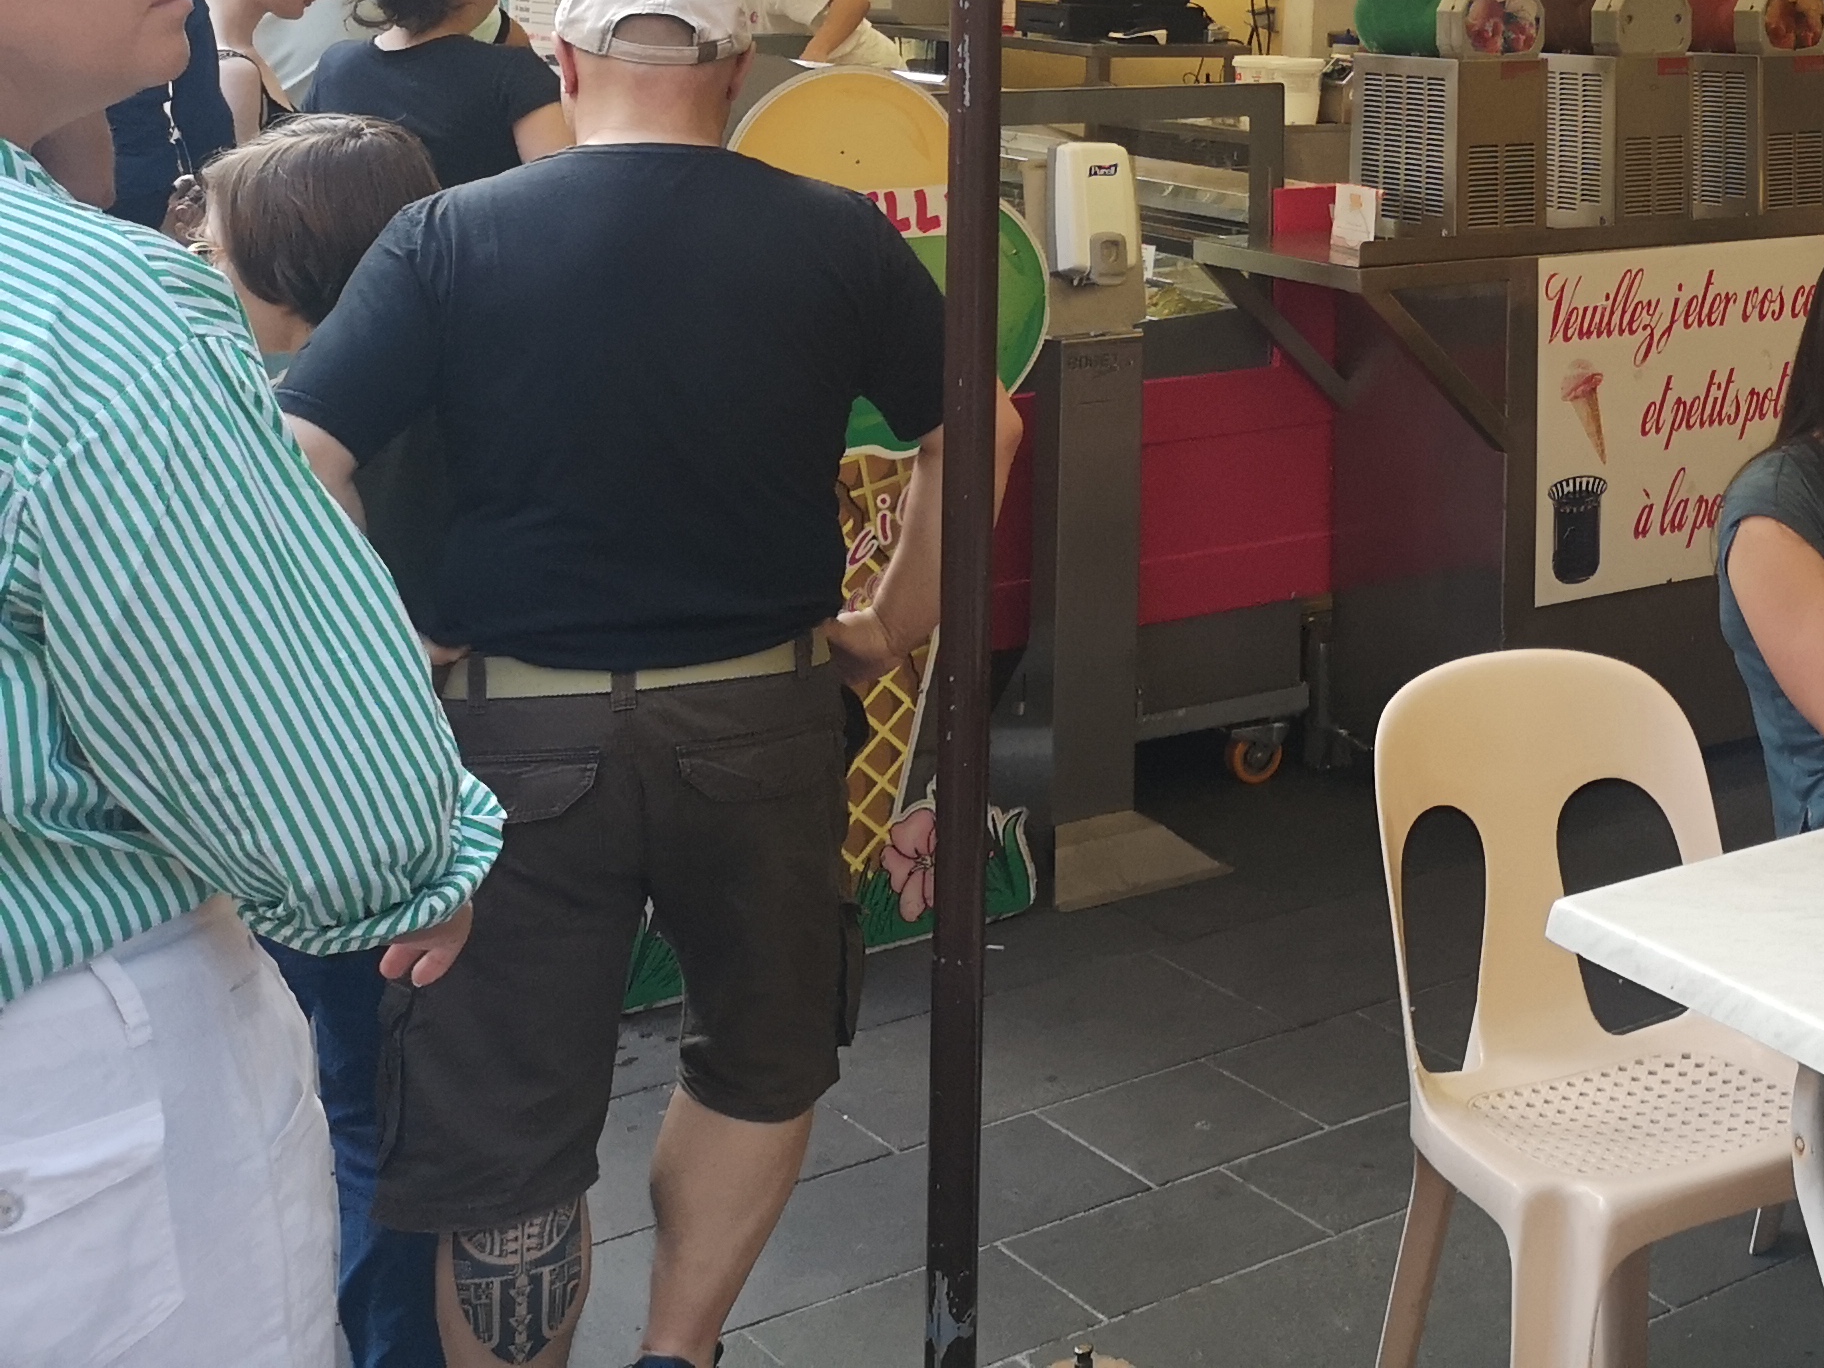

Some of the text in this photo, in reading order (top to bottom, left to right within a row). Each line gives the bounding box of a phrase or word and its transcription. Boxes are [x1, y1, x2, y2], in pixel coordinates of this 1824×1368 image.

[1545, 268, 1663, 367] Veuillez
[1657, 269, 1738, 354] jeter
[1741, 283, 1785, 323] vos
[1640, 361, 1792, 450] et petits pot
[1633, 488, 1655, 540] à
[1659, 467, 1689, 536] la
